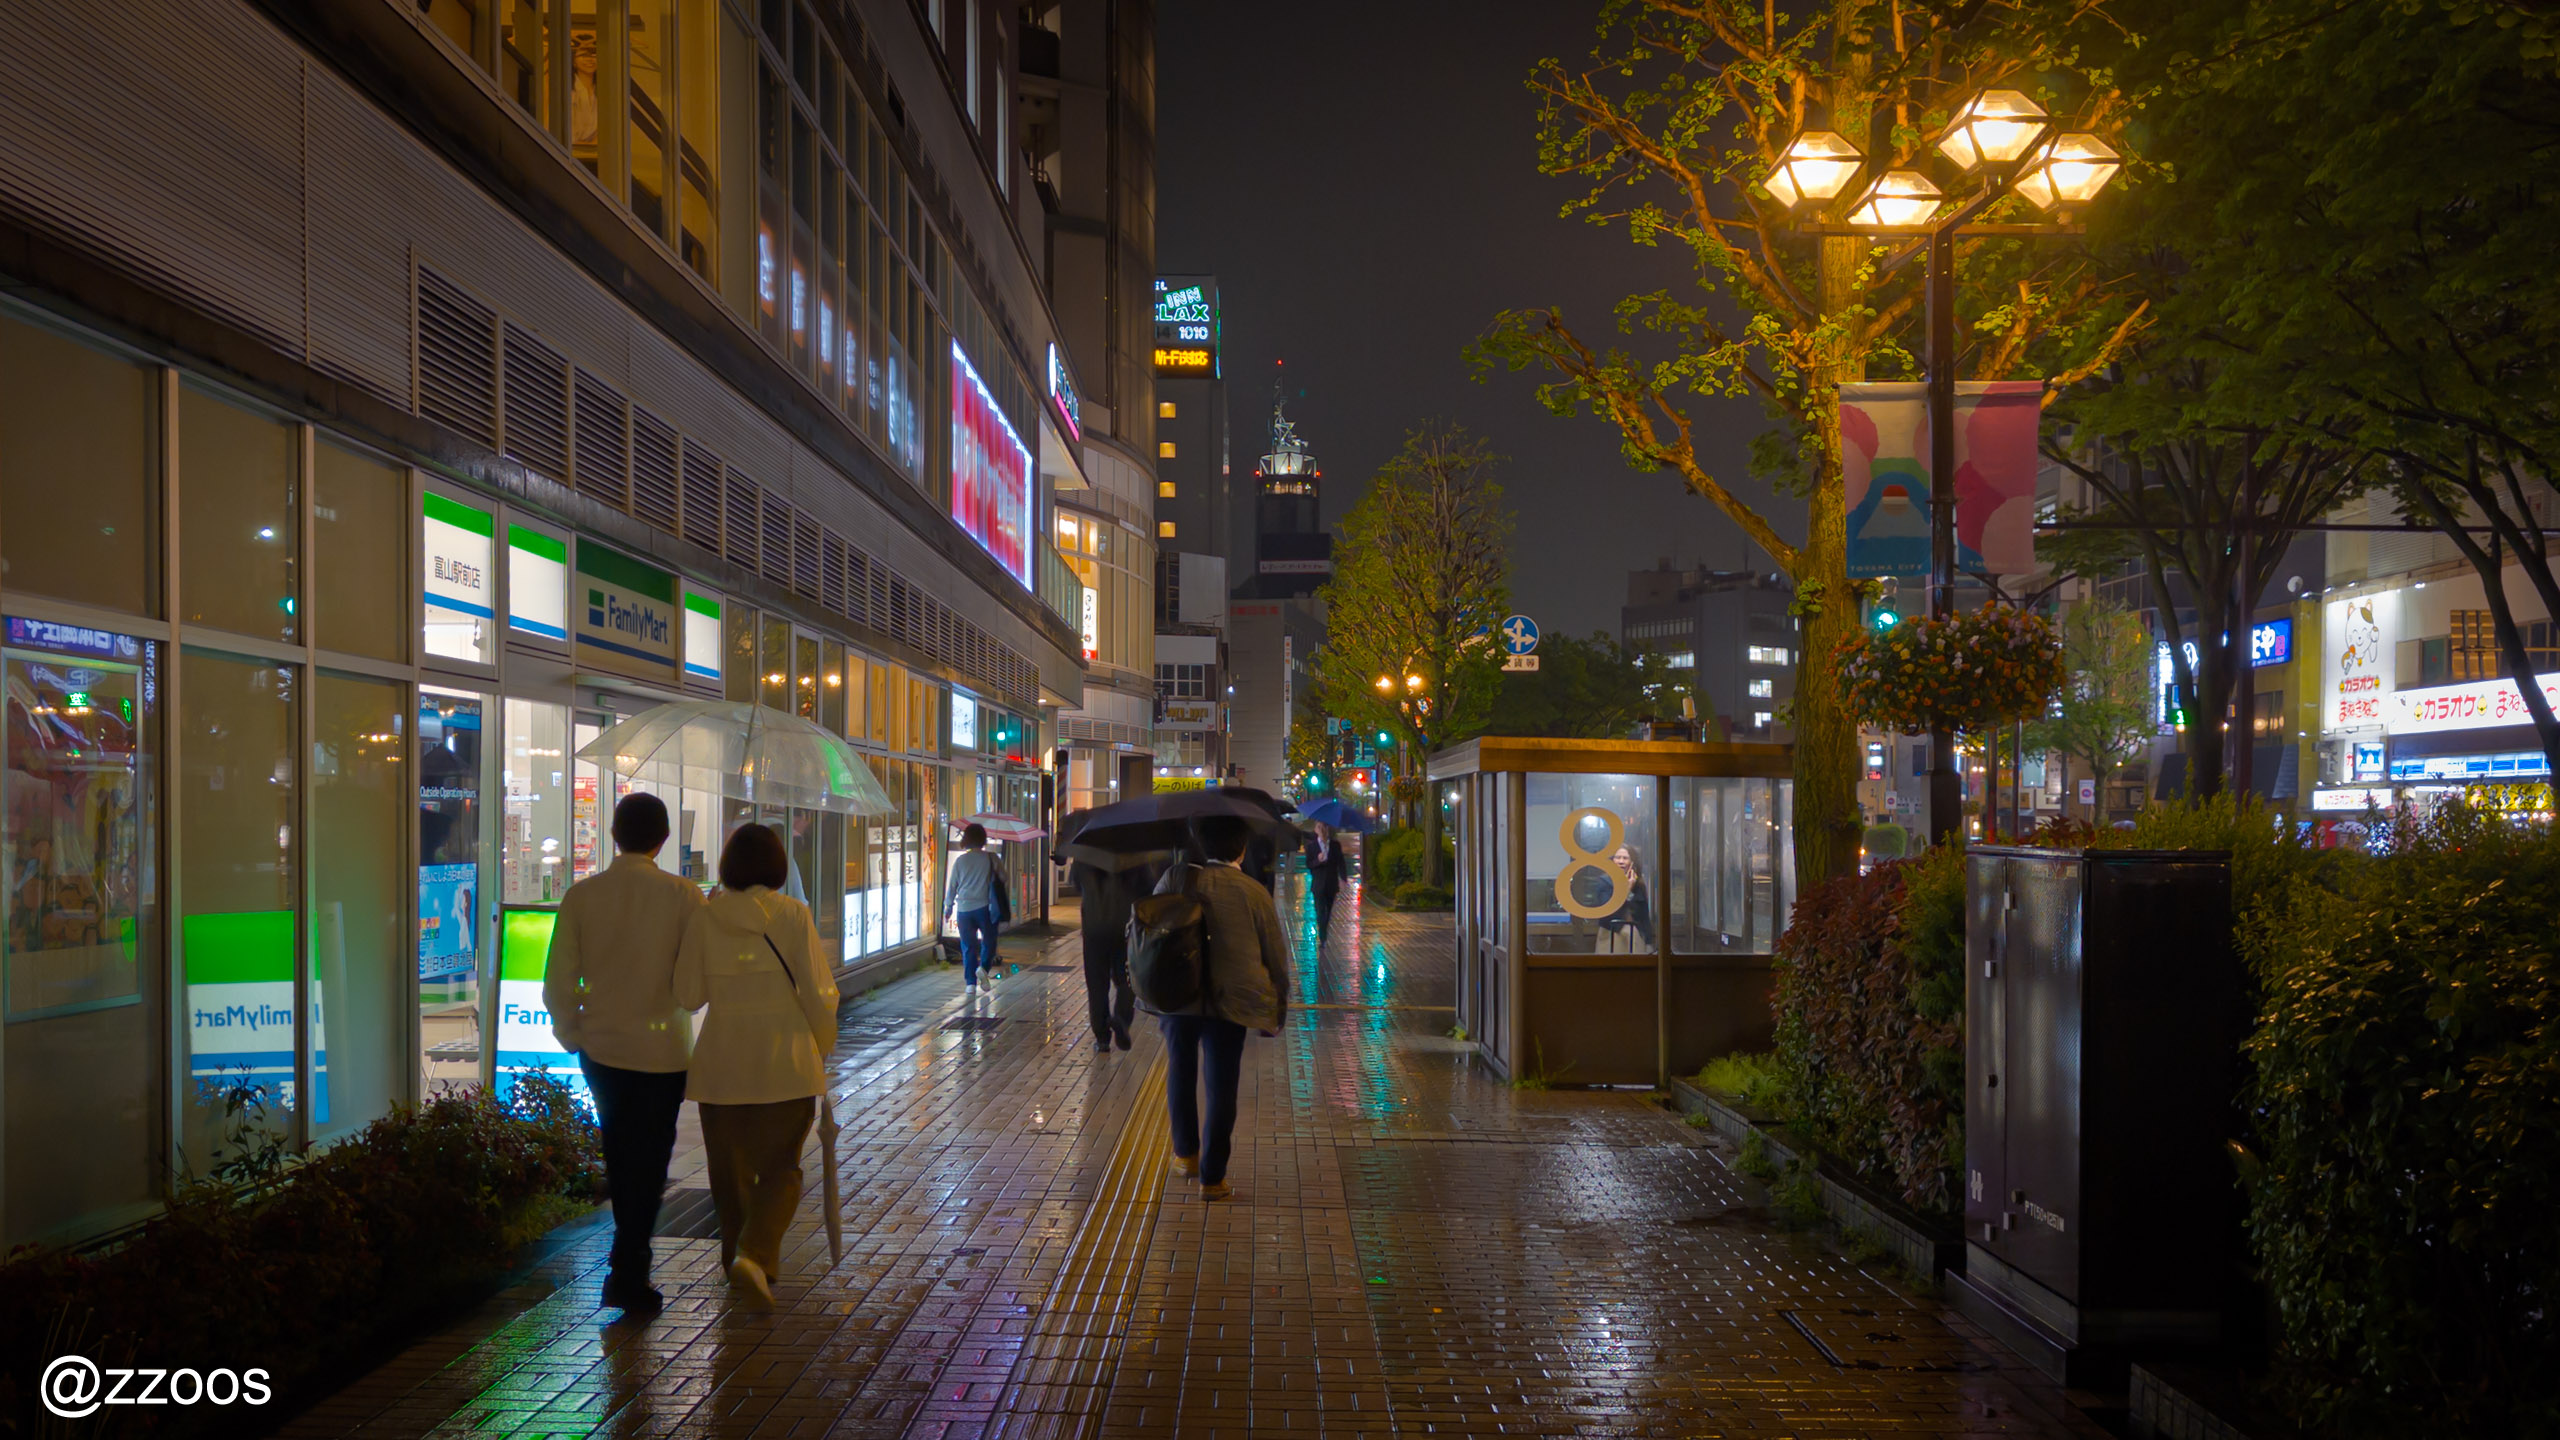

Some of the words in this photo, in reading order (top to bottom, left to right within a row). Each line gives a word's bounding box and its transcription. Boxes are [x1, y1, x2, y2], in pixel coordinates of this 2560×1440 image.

[1166, 287, 1201, 309] INN
[1155, 304, 1209, 322] LAX
[1179, 326, 1208, 339] 1010
[434, 555, 480, 590] 富山駅前店
[1851, 564, 1893, 573] TOYAMA
[1898, 563, 1924, 572] CITY
[608, 594, 668, 645] FamilyMart
[2344, 677, 2375, 693] カラオケ
[2338, 698, 2379, 722] まねきねこ
[2424, 694, 2477, 720] カラオケ
[2496, 686, 2558, 719] まねこ
[420, 785, 439, 798] Outside
[440, 787, 463, 800] Operating
[463, 788, 477, 799] Hours
[1554, 806, 1630, 919] 8
